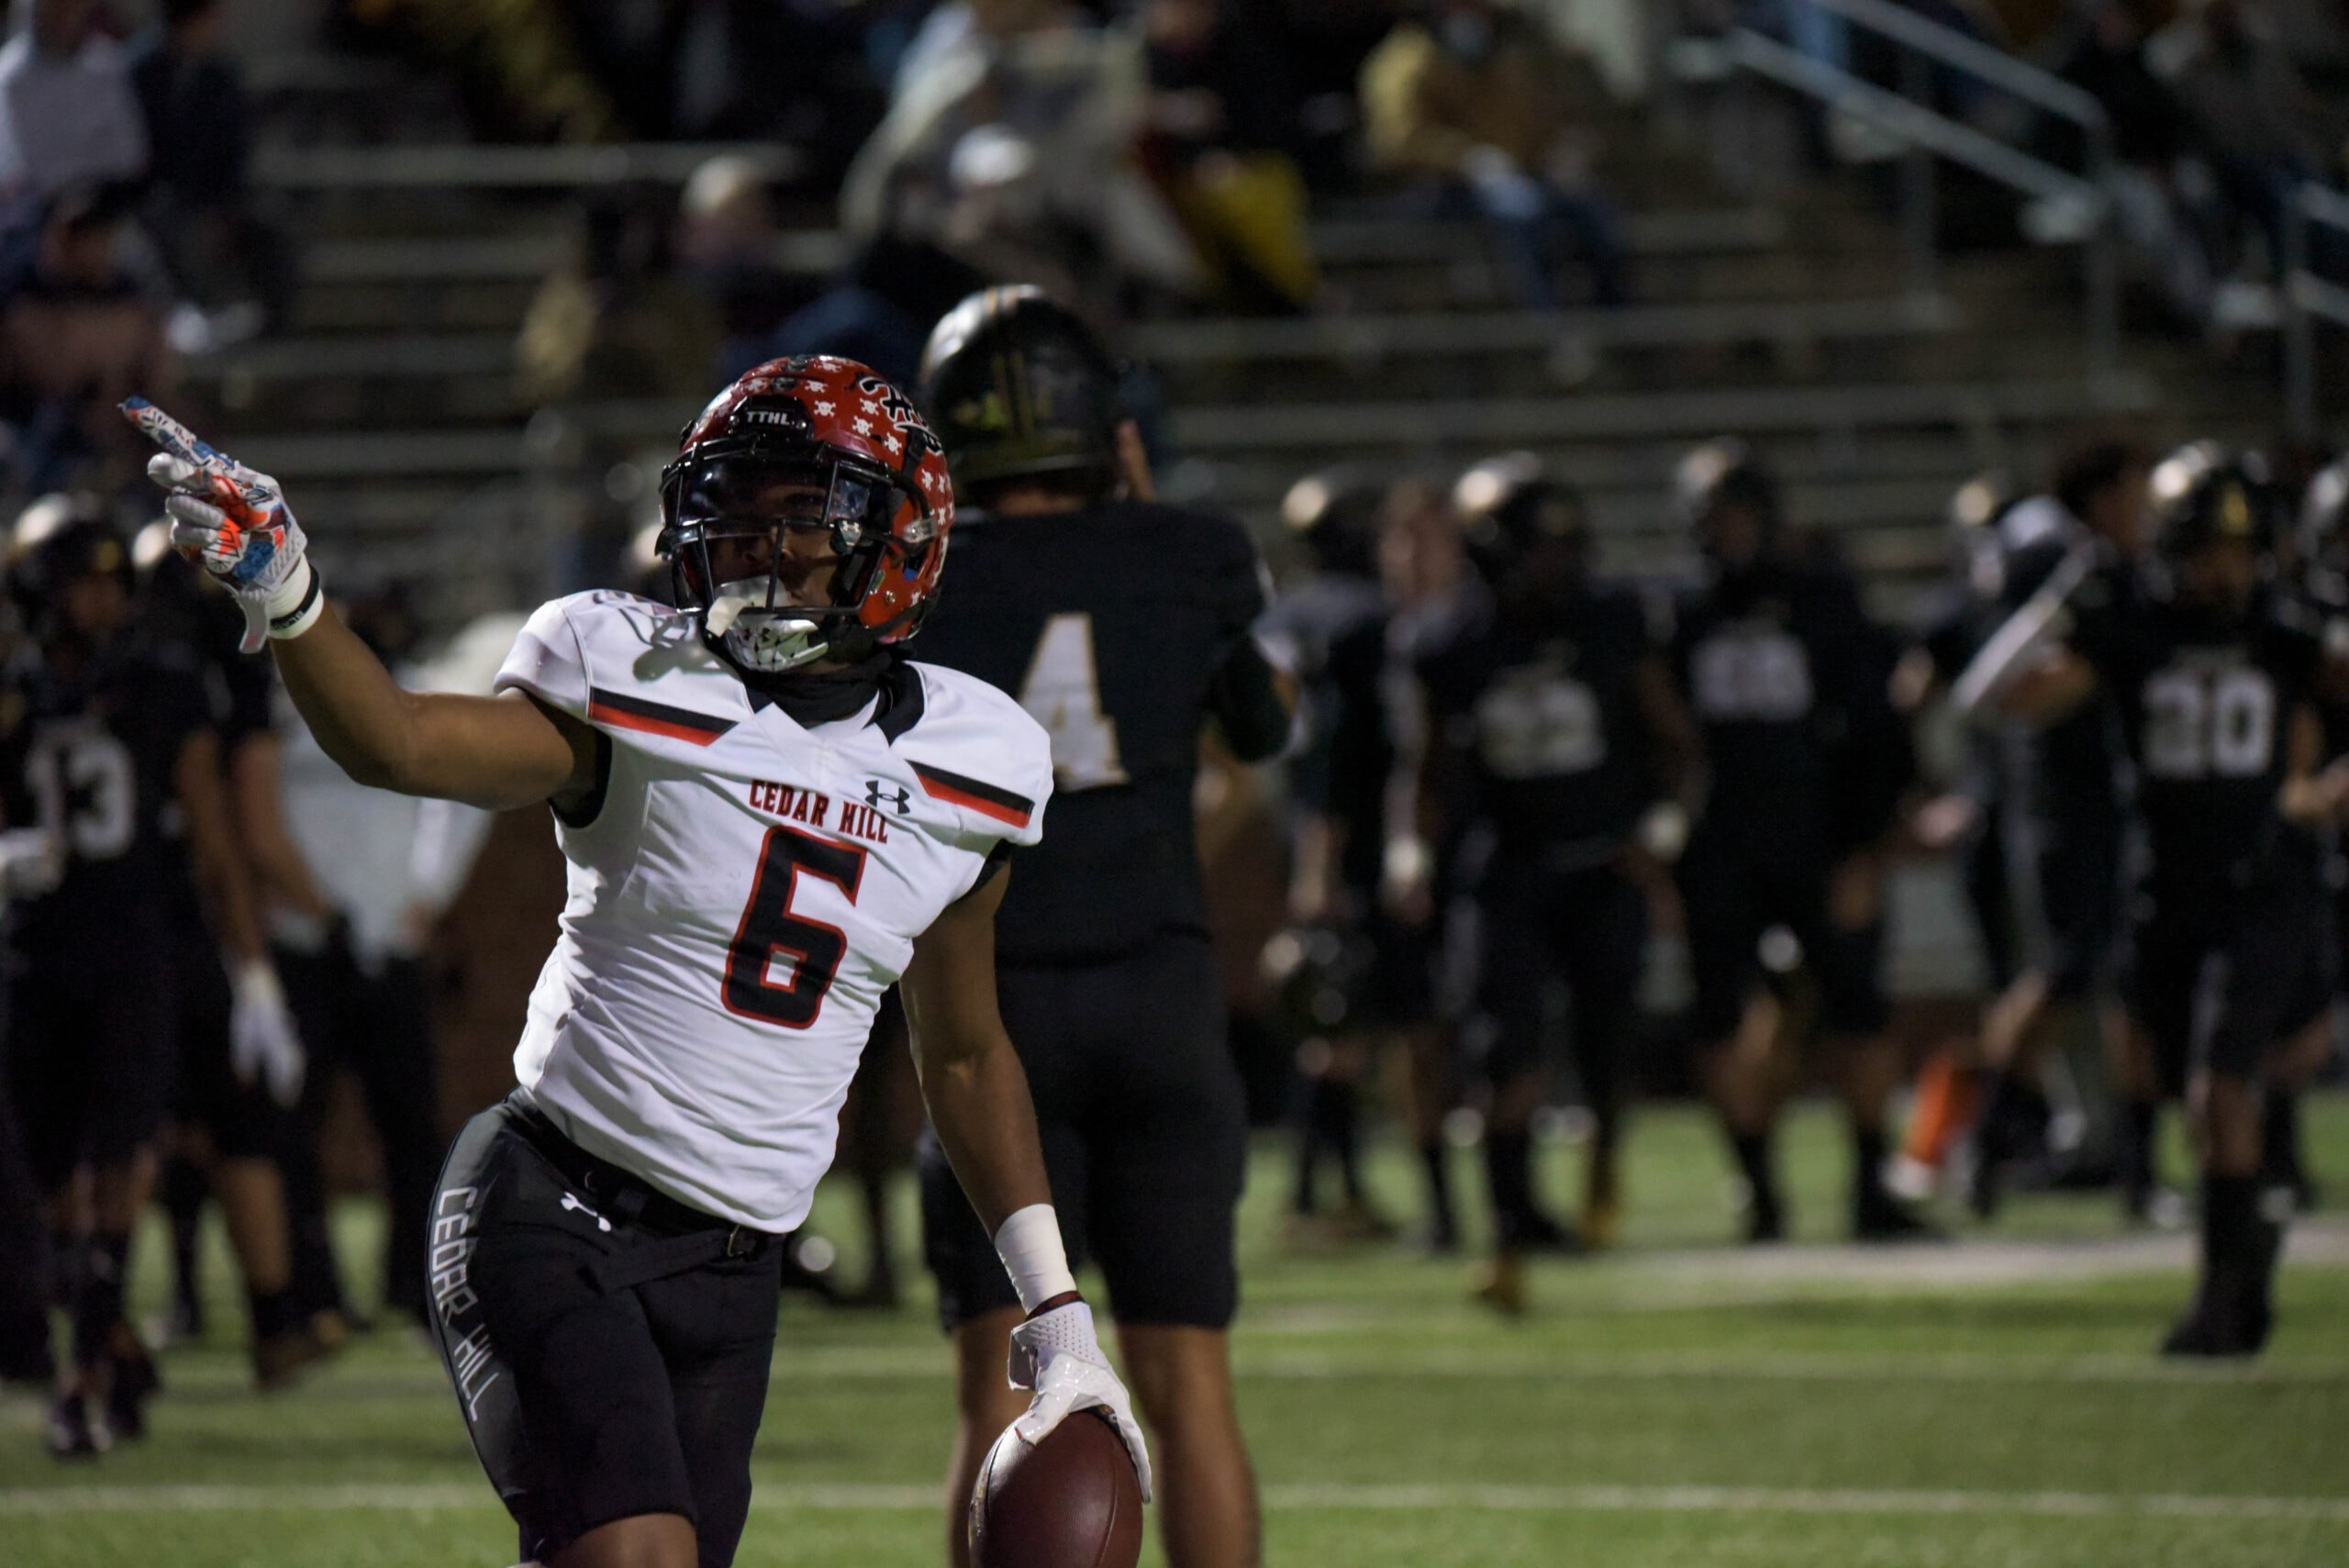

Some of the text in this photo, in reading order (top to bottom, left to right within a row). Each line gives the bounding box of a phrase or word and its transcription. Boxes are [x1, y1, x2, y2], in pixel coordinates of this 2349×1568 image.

[1017, 611, 1130, 792] 4
[749, 780, 888, 843] CEDAR HILL
[721, 825, 868, 1029] 6
[431, 1186, 499, 1421] CEDAR HILL
